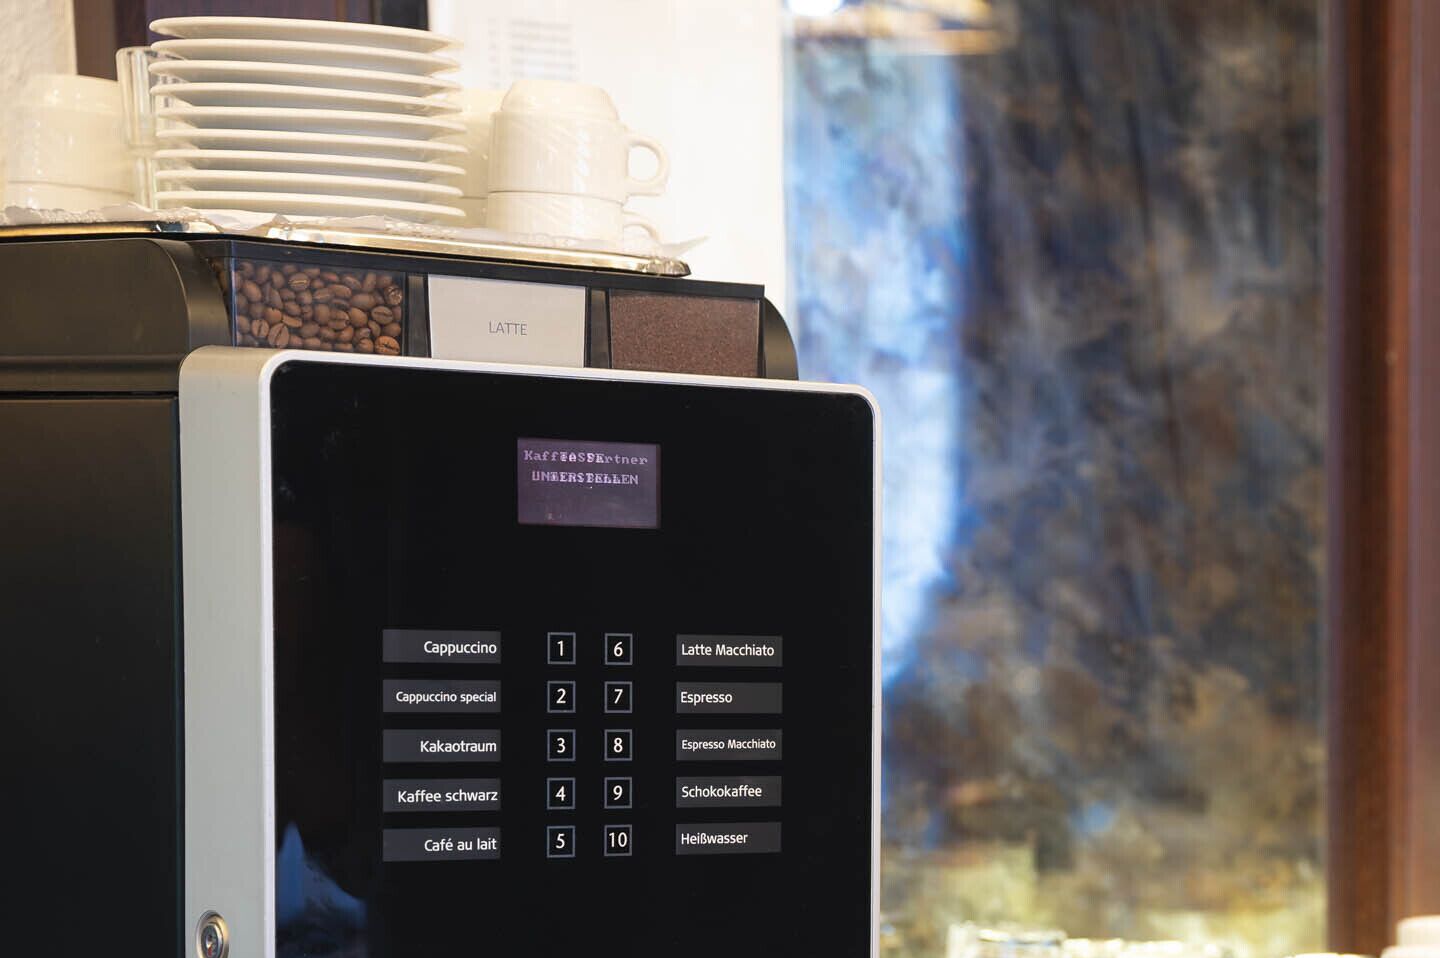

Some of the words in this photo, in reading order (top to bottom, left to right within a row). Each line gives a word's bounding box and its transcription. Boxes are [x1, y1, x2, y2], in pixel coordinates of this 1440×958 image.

[489, 321, 528, 336] LATTE
[423, 640, 498, 657] Cappuccino
[557, 640, 565, 657] 1
[613, 641, 624, 657] 6
[681, 643, 713, 656] Latte
[715, 643, 775, 657] Macchiato
[395, 690, 458, 705] Cappuccino
[459, 690, 497, 705] special
[556, 688, 567, 704] 2
[614, 688, 624, 704] 7
[680, 690, 733, 705] Espresso
[420, 739, 497, 753] Kakaotraum
[556, 737, 567, 754] 3
[613, 737, 624, 753] 8
[681, 739, 726, 751] Espresso
[727, 738, 777, 750] Macchiato
[397, 789, 442, 803] Kaffee
[445, 788, 499, 802] schwarz
[555, 785, 567, 802] 4
[613, 785, 623, 801] 9
[681, 784, 763, 798] Schokokaffee
[424, 837, 454, 852] Café
[456, 841, 473, 851] au
[476, 837, 497, 851] lait
[555, 833, 565, 849] 5
[608, 832, 628, 848] 10
[681, 832, 749, 845] Heißwasser
